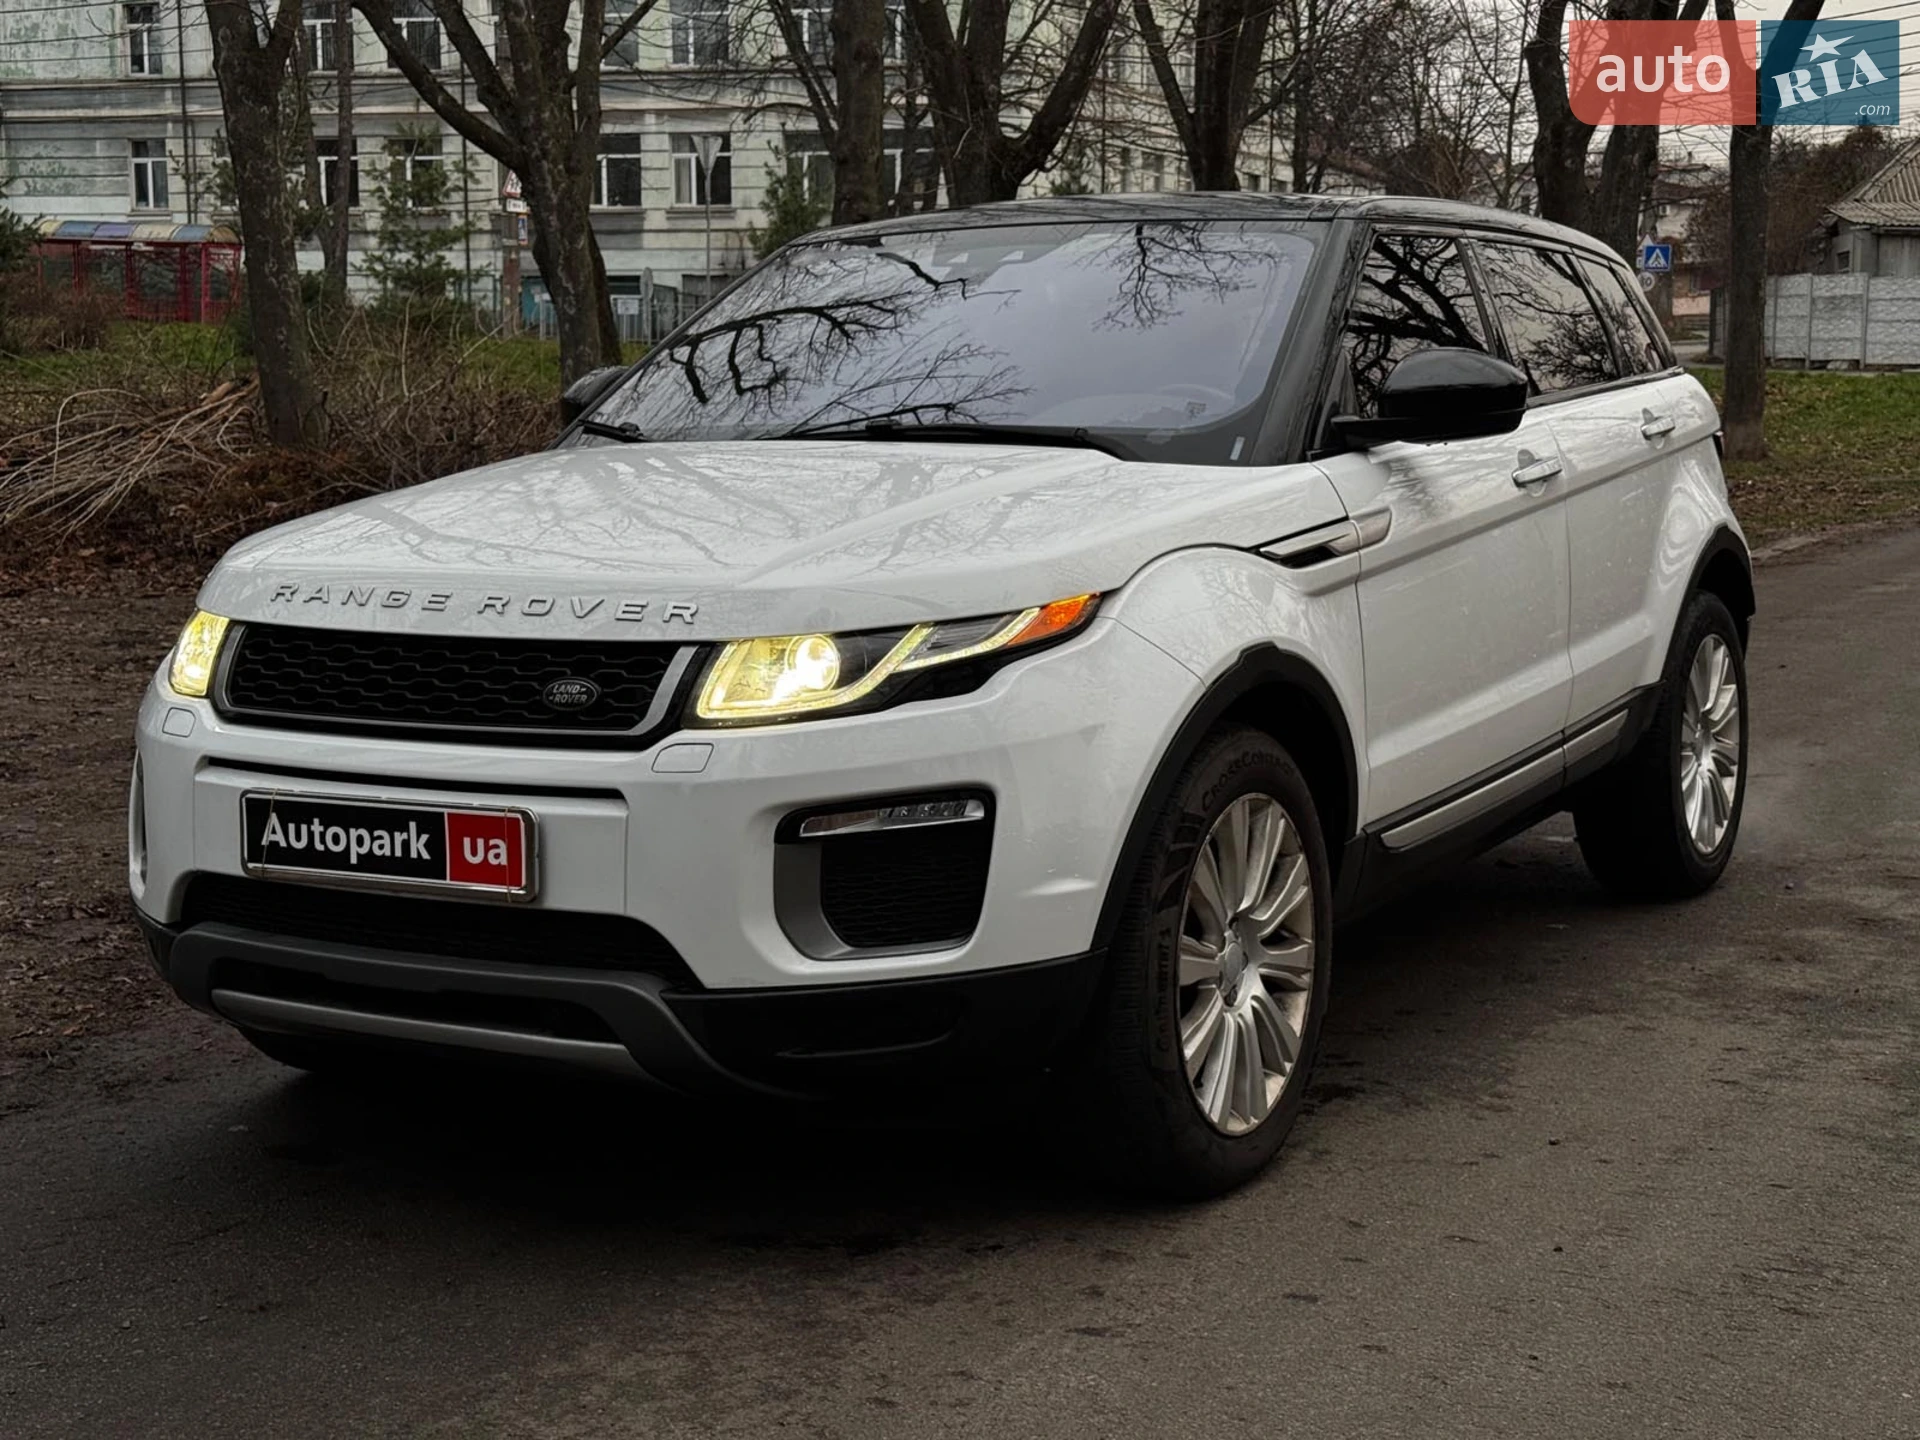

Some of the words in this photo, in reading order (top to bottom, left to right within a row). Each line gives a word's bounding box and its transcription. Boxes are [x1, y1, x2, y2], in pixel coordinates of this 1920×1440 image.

[269, 582, 453, 612] RANGE
[477, 594, 700, 624] ROVER
[261, 811, 431, 865] Autopark
[463, 835, 508, 866] ua
